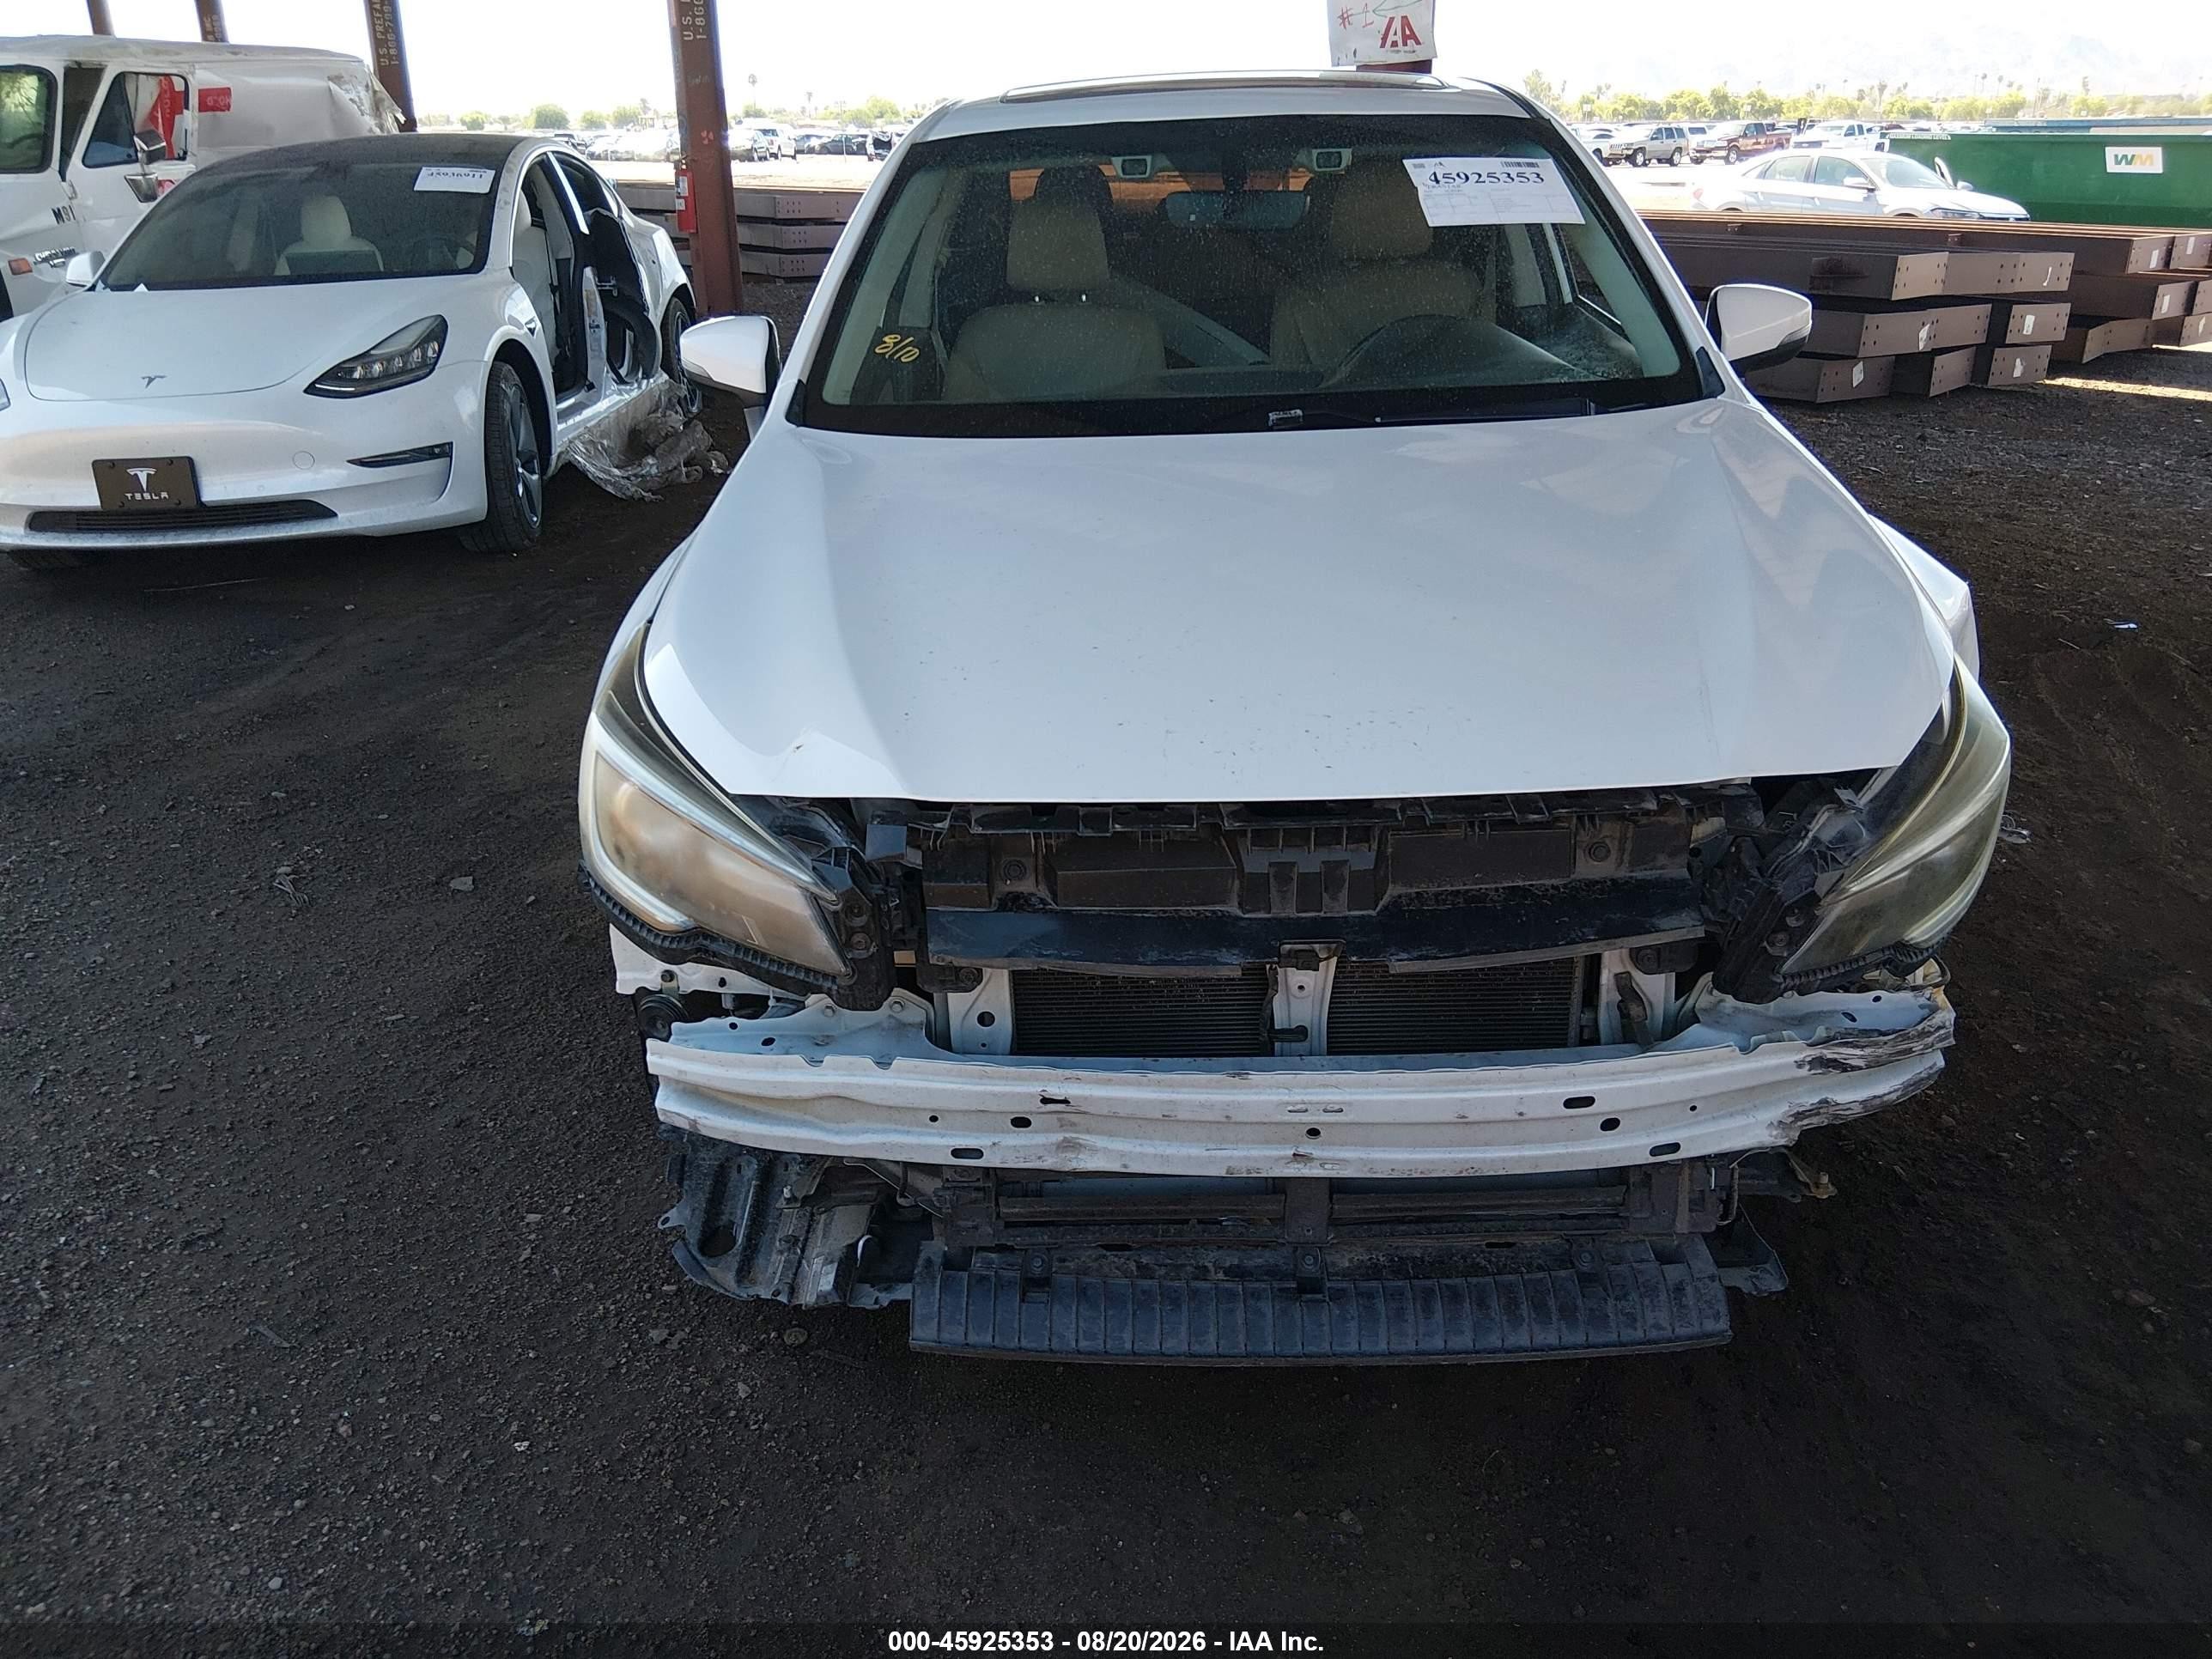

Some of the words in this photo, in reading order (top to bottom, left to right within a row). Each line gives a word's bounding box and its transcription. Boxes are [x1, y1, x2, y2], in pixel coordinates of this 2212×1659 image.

[372, 0, 386, 40] PREFA
[682, 11, 694, 40] U.S.
[2114, 153, 2154, 166] WM
[1428, 171, 1545, 185] 45925353
[125, 491, 169, 501] TESLA
